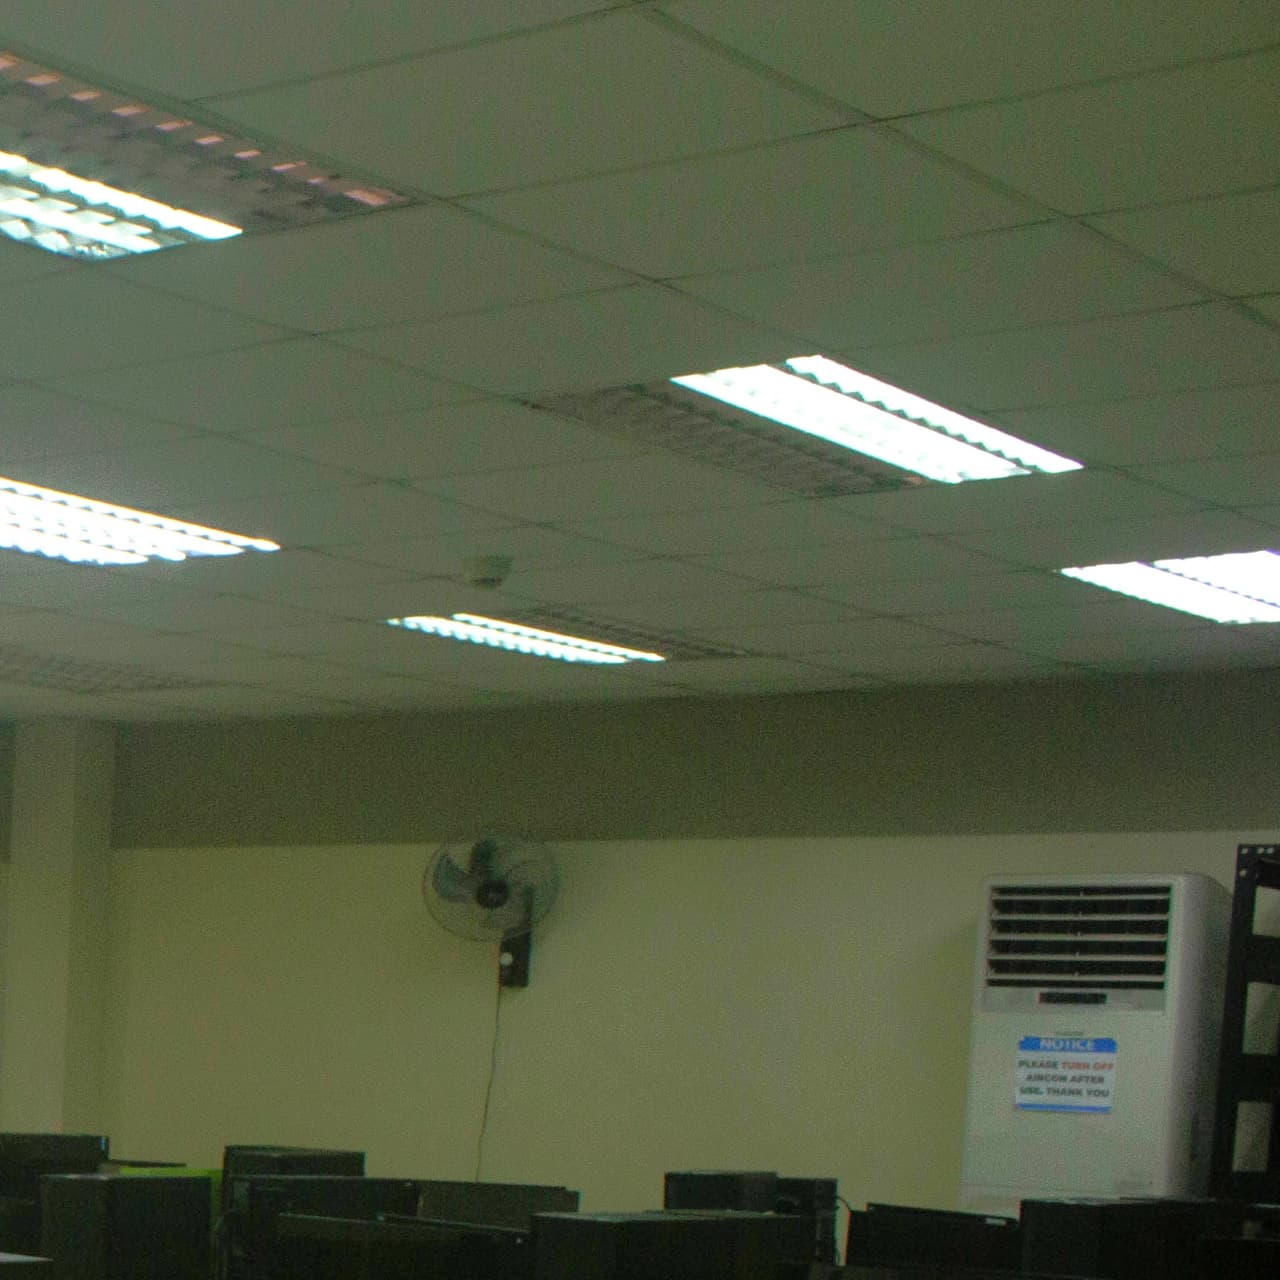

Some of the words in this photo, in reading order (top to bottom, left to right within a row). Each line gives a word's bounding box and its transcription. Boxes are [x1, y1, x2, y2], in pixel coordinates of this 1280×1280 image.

[1040, 1039, 1093, 1051] NOTICE
[1018, 1061, 1058, 1069] PLEASE
[1061, 1062, 1089, 1070] TURN
[1092, 1063, 1114, 1071] OFF
[1026, 1074, 1068, 1082] AIRCON
[1070, 1076, 1104, 1084] AFTER
[1046, 1088, 1082, 1096] THANK
[1086, 1089, 1110, 1097] YOU
